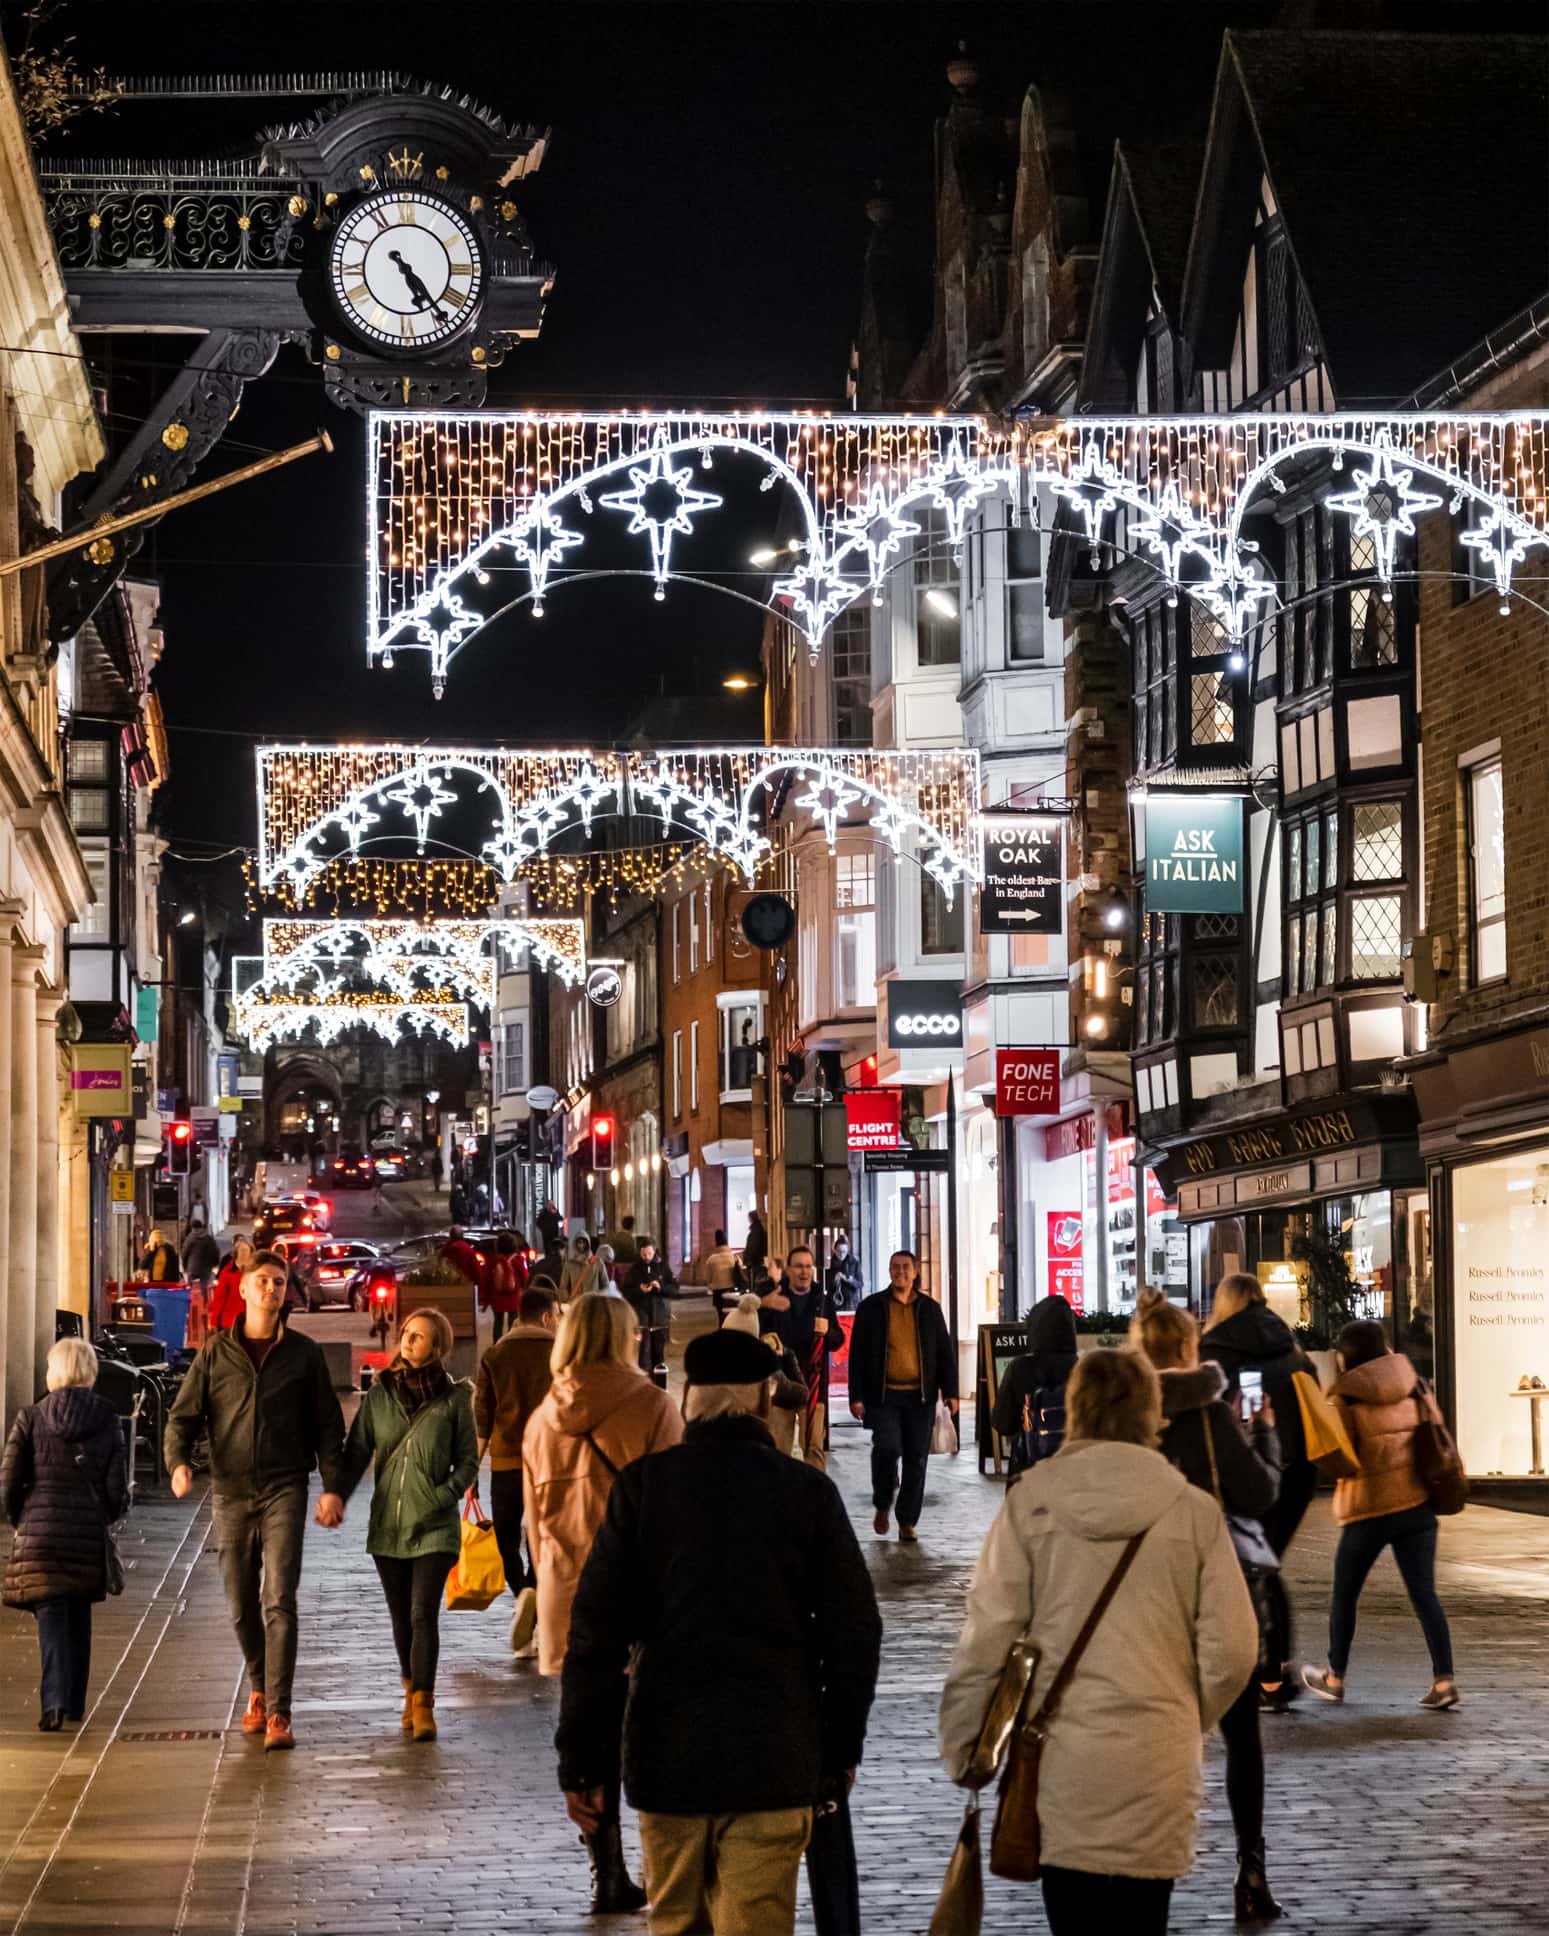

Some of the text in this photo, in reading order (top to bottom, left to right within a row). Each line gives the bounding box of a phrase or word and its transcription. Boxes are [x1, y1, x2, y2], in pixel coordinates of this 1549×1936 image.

[989, 829, 1052, 845] ROYAL
[1173, 829, 1215, 852] ASK
[999, 847, 1042, 864] OAK
[1152, 858, 1237, 882] ITALIAN
[987, 875, 1006, 885] The
[1007, 874, 1036, 886] oldest
[996, 887, 1046, 900] in England
[895, 1014, 961, 1035] ecco
[1002, 1063, 1055, 1081] FONE
[1004, 1085, 1054, 1102] TECH
[849, 1122, 894, 1134] FLIGHT
[848, 1135, 897, 1146] CENTRE
[1468, 1266, 1502, 1279] Russell
[1469, 1290, 1503, 1302] Russell
[1470, 1314, 1503, 1326] Russell
[995, 1335, 1016, 1347] ASK
